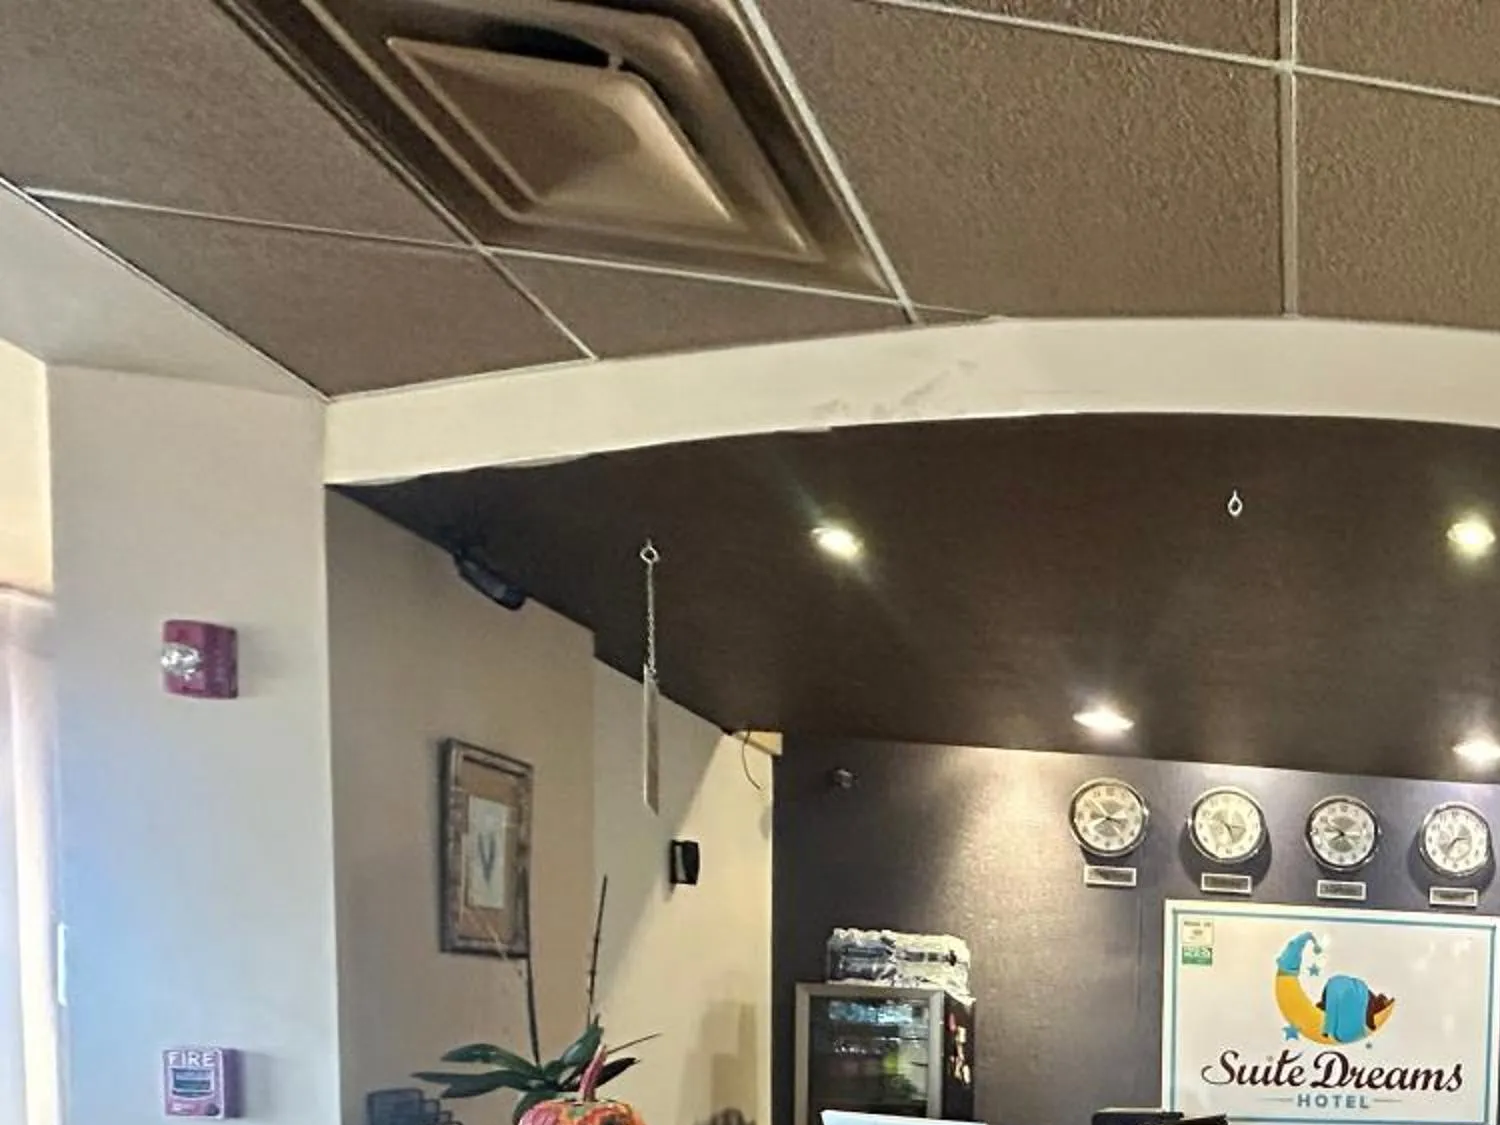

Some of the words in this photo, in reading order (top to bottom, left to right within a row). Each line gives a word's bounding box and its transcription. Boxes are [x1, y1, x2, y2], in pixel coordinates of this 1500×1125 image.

[167, 1051, 216, 1068] FIRE
[1201, 1049, 1305, 1087] Suite
[1309, 1050, 1464, 1092] Dreams
[1297, 1093, 1371, 1109] HOTEL
